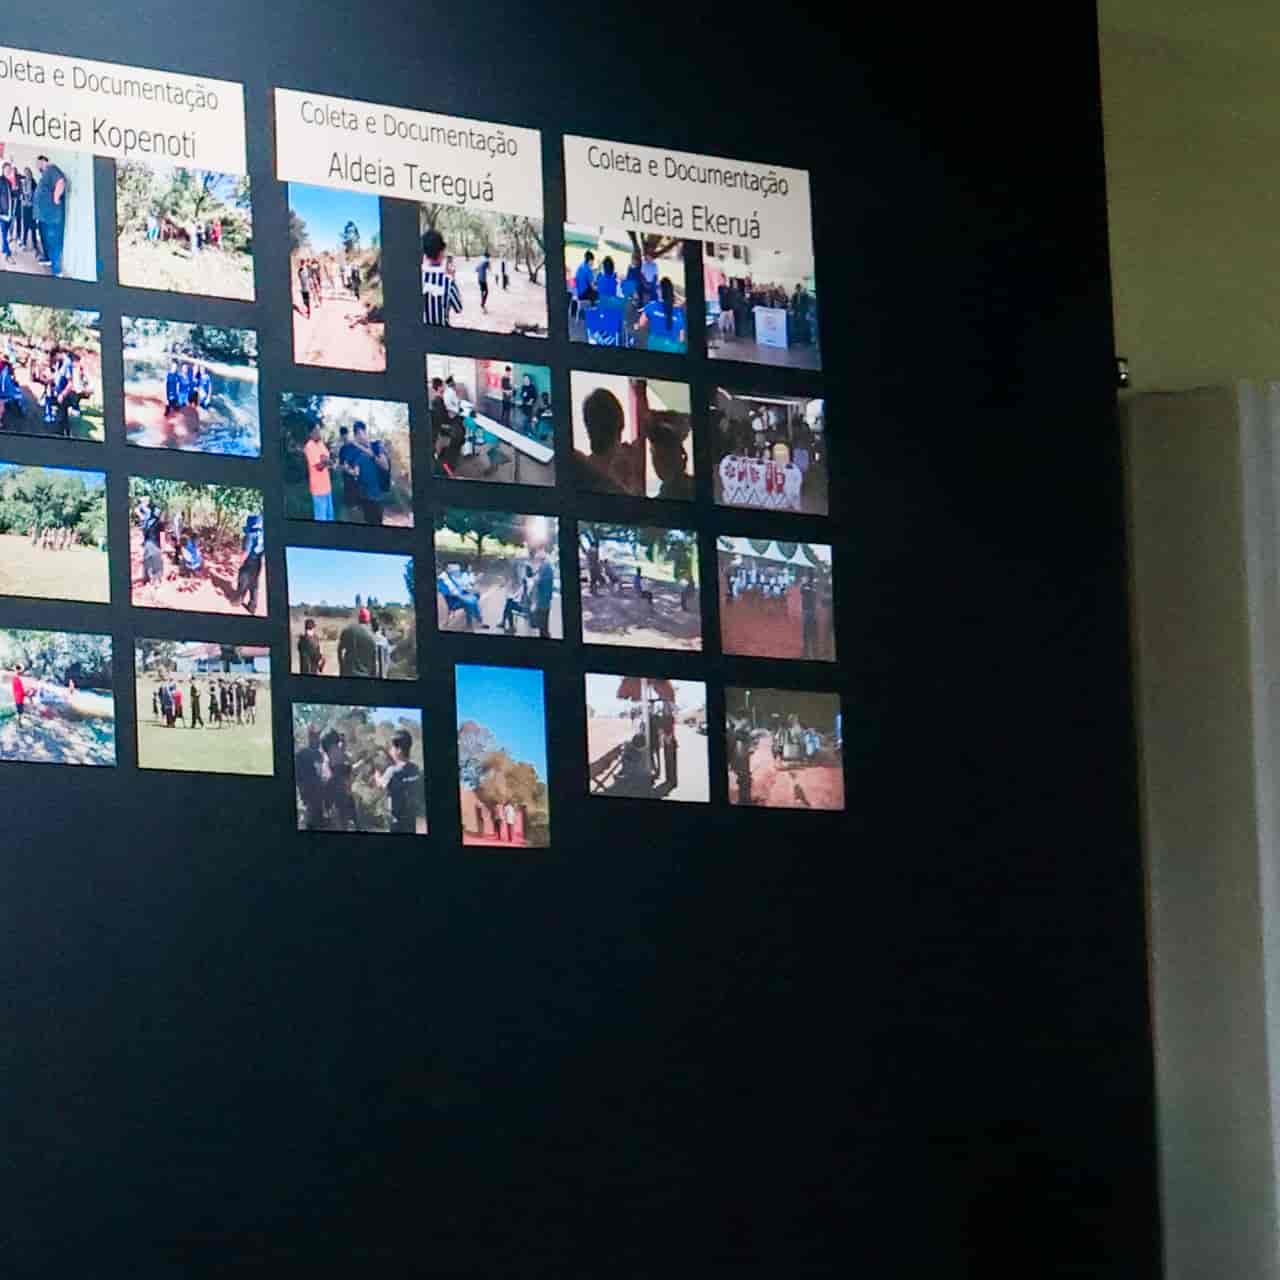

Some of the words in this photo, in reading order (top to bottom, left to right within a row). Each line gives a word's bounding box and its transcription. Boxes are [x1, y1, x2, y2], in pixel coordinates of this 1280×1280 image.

[51, 67, 65, 87] e
[71, 64, 218, 113] Documentação
[7, 105, 83, 143] Aldeia
[91, 116, 197, 160] Kopenoti
[299, 99, 359, 131] Coleta
[364, 114, 377, 135] e
[382, 112, 518, 159] Documentação
[326, 150, 396, 188] Aldeia
[402, 162, 495, 205] Tereguá
[586, 143, 642, 175] Coleta
[646, 158, 659, 177] e
[663, 155, 789, 199] Documentação
[619, 194, 684, 230] Aldeia
[690, 203, 761, 240] Ekeruá
